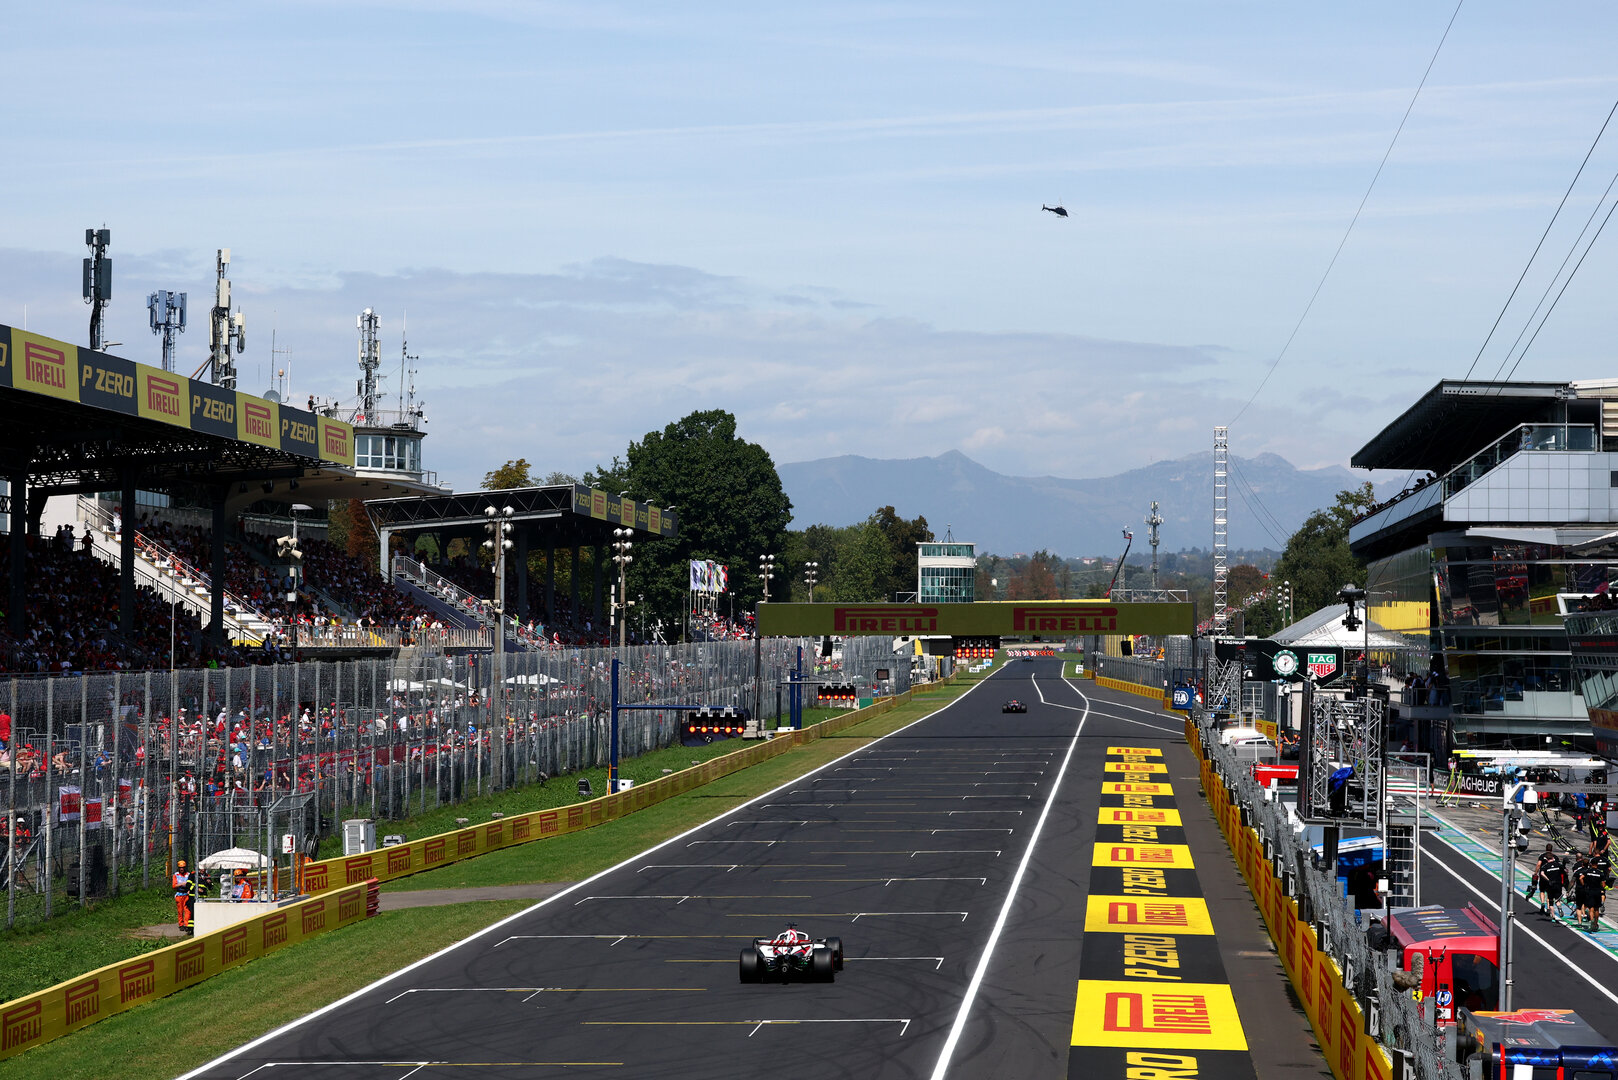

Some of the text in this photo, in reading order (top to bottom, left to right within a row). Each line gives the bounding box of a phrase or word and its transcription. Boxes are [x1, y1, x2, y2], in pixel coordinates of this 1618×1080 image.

[25, 342, 66, 389] PIRELLI
[82, 365, 134, 398] P ZERO
[147, 374, 180, 416] PIRELLI
[192, 395, 234, 424] P ZERO
[245, 402, 272, 438] PIRELLI
[282, 418, 316, 444] P ZERO
[324, 424, 347, 457] PIRELLI
[834, 608, 938, 631] PIRELLI
[1013, 608, 1118, 631] PIRELLI
[1310, 655, 1333, 663] TAG
[425, 838, 446, 864] PIRELLI
[458, 831, 476, 855] PIRELLI
[345, 856, 372, 884] PIRELLI
[388, 847, 410, 874] PIRELLI
[302, 900, 325, 934] PIRELLI
[339, 889, 360, 922] PIRELLI
[1108, 902, 1188, 926] PIRELLI
[222, 926, 248, 965] PIRELLI
[263, 912, 287, 949] PIRELLI
[175, 942, 204, 984] PIRELLI
[1124, 935, 1182, 980] P ZERO
[119, 960, 155, 1003] PIRELLI
[65, 978, 99, 1026] PIRELLI
[1104, 992, 1211, 1034] PIRELLI
[2, 1000, 42, 1050] PIRELLI
[1126, 1052, 1199, 1080] RO
